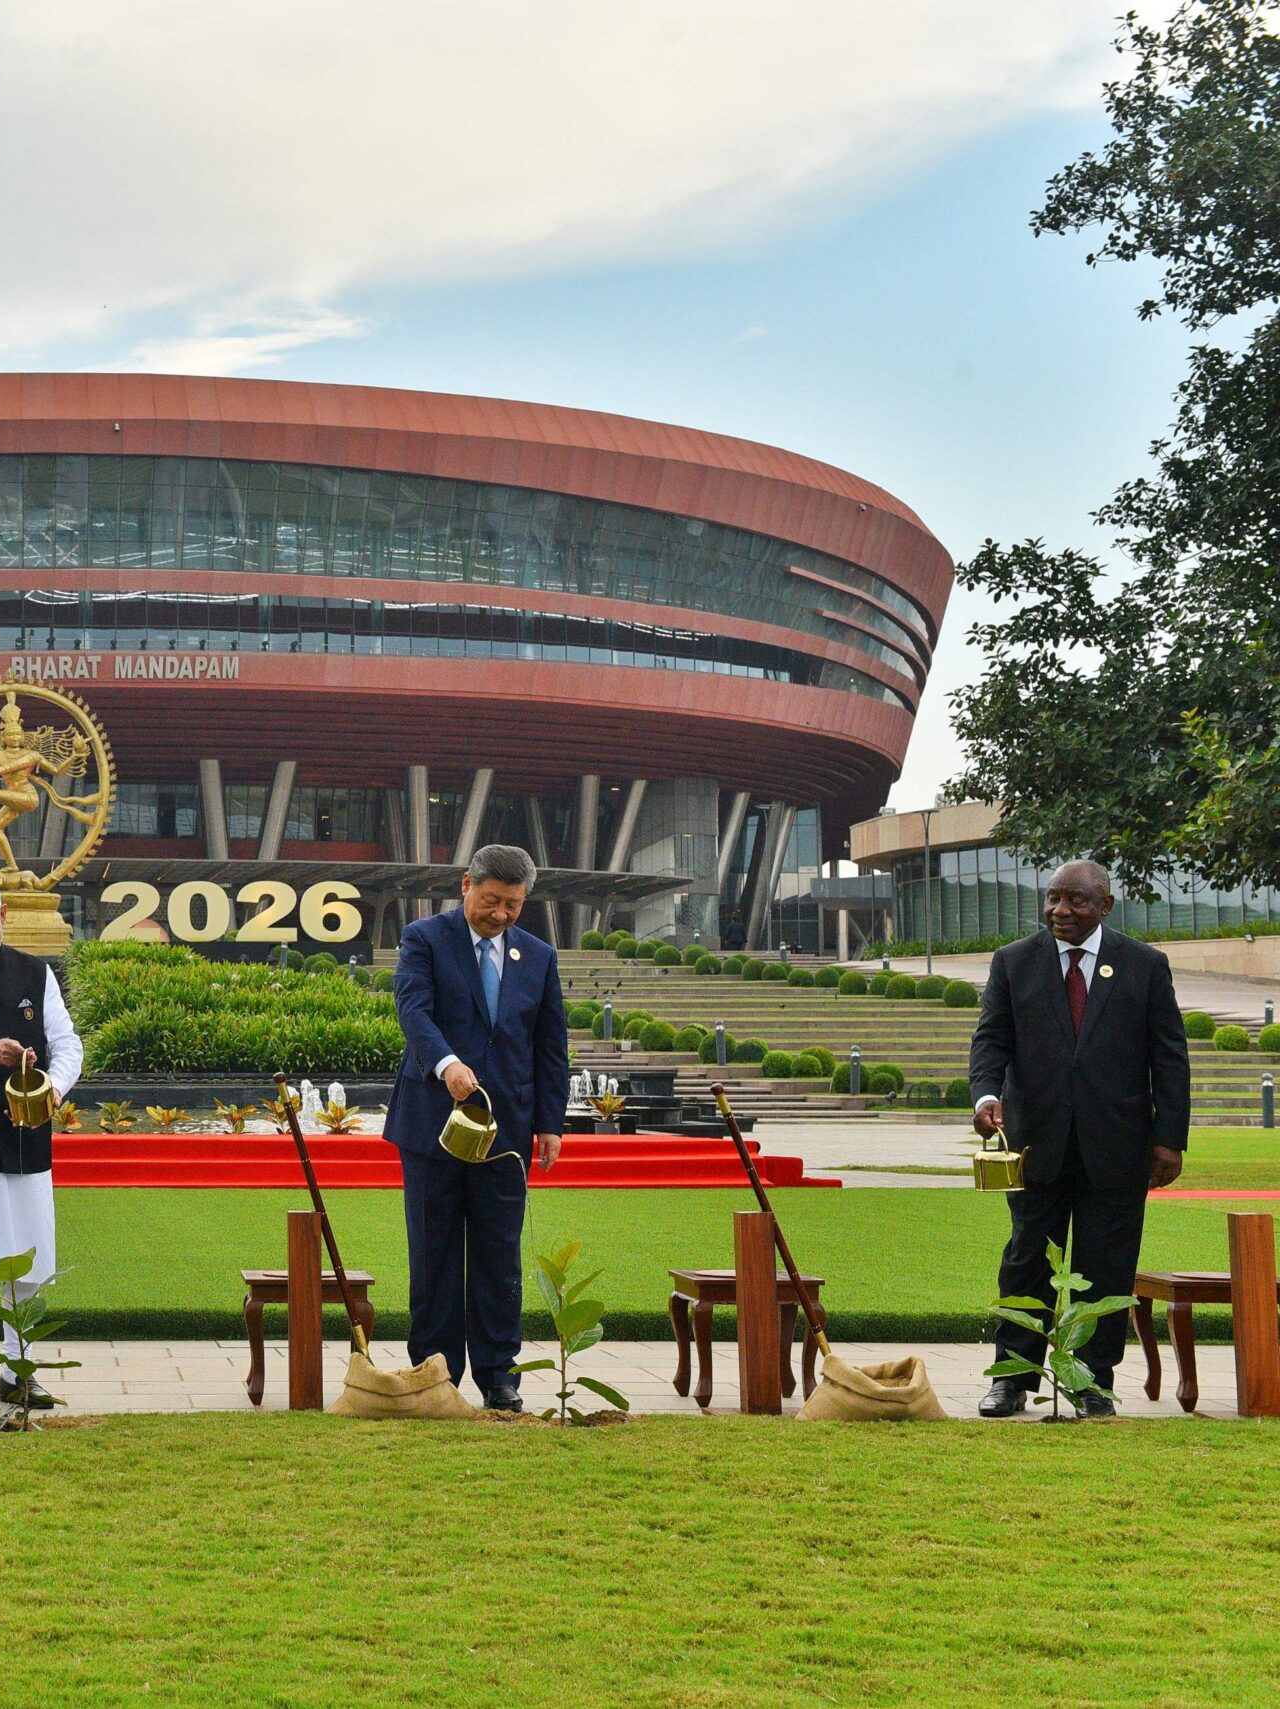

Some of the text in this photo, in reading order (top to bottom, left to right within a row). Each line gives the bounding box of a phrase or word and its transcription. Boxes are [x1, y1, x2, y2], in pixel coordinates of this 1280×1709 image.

[11, 655, 240, 680] BHARAT MANDAPAM
[99, 880, 363, 943] 2026
